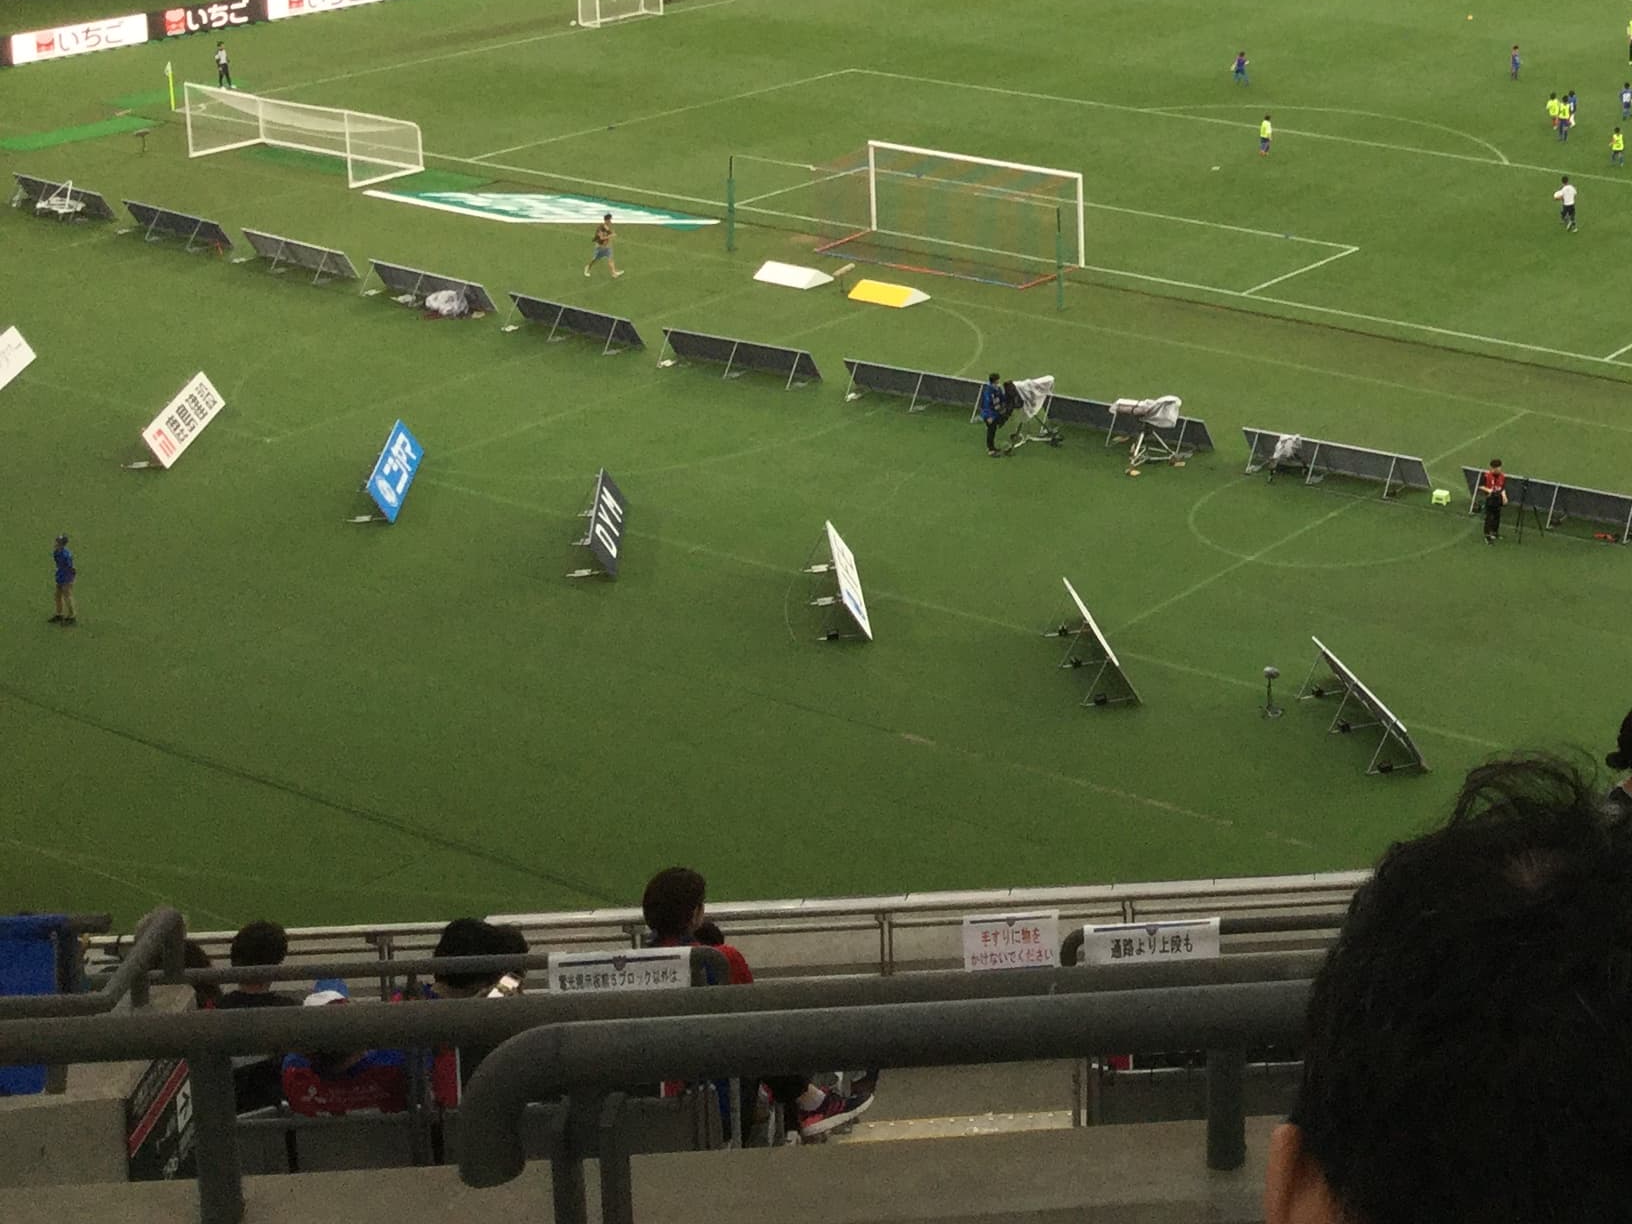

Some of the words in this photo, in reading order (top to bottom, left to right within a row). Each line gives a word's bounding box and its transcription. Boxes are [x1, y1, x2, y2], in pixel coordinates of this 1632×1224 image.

[58, 20, 126, 51] いちご
[595, 485, 624, 559] DYM
[981, 927, 1041, 946] 手すりに物を
[1111, 934, 1193, 960] 通路より上段も
[971, 947, 1054, 964] かけないでください
